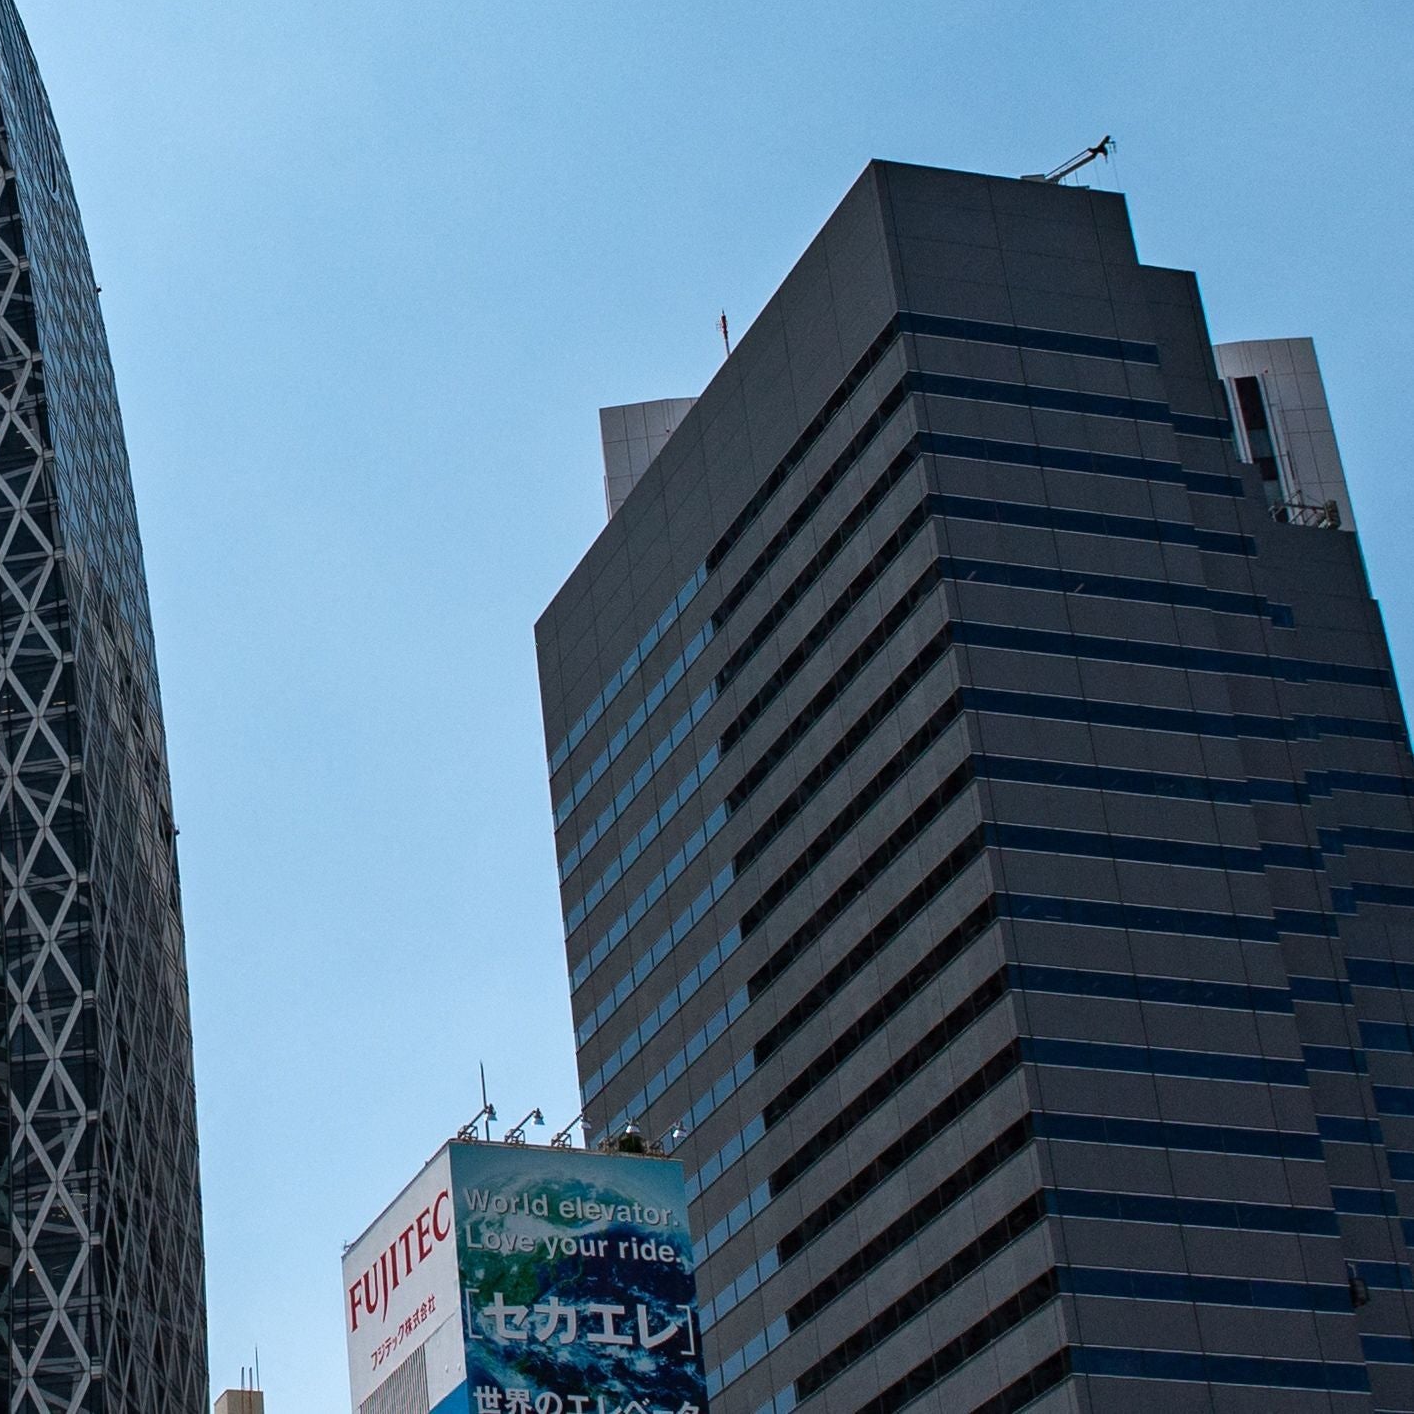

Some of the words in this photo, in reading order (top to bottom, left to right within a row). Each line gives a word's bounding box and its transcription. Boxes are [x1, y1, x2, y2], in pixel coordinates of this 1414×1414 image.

[463, 1187, 549, 1218] World
[558, 1196, 680, 1227] elevator.
[348, 1188, 452, 1334] FUJITEC
[465, 1223, 537, 1253] Love
[544, 1236, 609, 1260] your
[618, 1237, 684, 1264] ride.
[370, 1294, 437, 1372] フジテック株式会社
